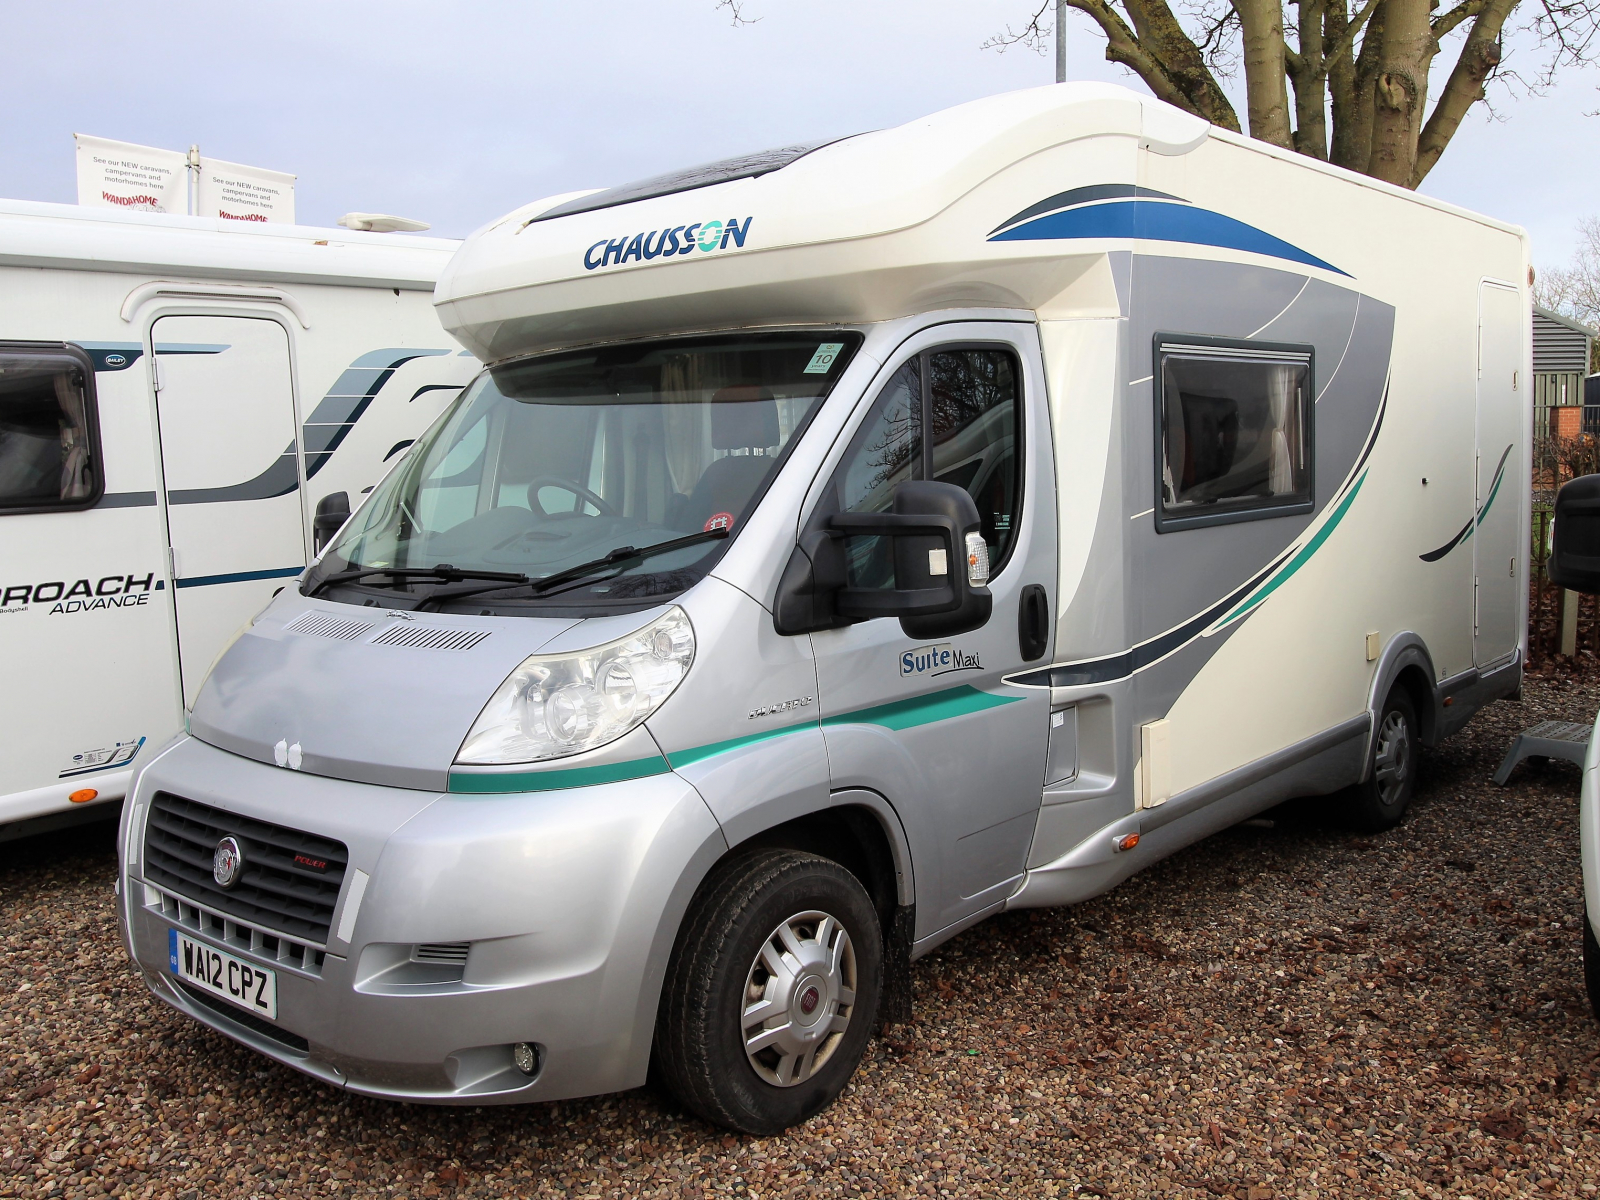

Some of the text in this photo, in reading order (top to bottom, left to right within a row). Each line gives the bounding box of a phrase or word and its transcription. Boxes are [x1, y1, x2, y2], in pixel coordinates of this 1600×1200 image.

[105, 168, 147, 179] campervans
[121, 161, 139, 169] NEW
[140, 165, 172, 175] caravans,
[104, 176, 164, 190] motorhomes here
[212, 176, 224, 185] See
[252, 185, 280, 195] caravans,
[102, 190, 158, 207] WANDAHOME
[222, 187, 259, 199] campervans
[221, 195, 259, 207] motorhomes
[584, 216, 753, 270] CHAUSSON
[815, 354, 833, 364] 10
[0, 572, 155, 607] ROACH
[49, 593, 150, 615] ADVANCE
[902, 647, 981, 674] Suite Maxi
[294, 855, 326, 869] POWER
[170, 955, 177, 965] GB
[183, 940, 268, 1009] WA12 CPZ
